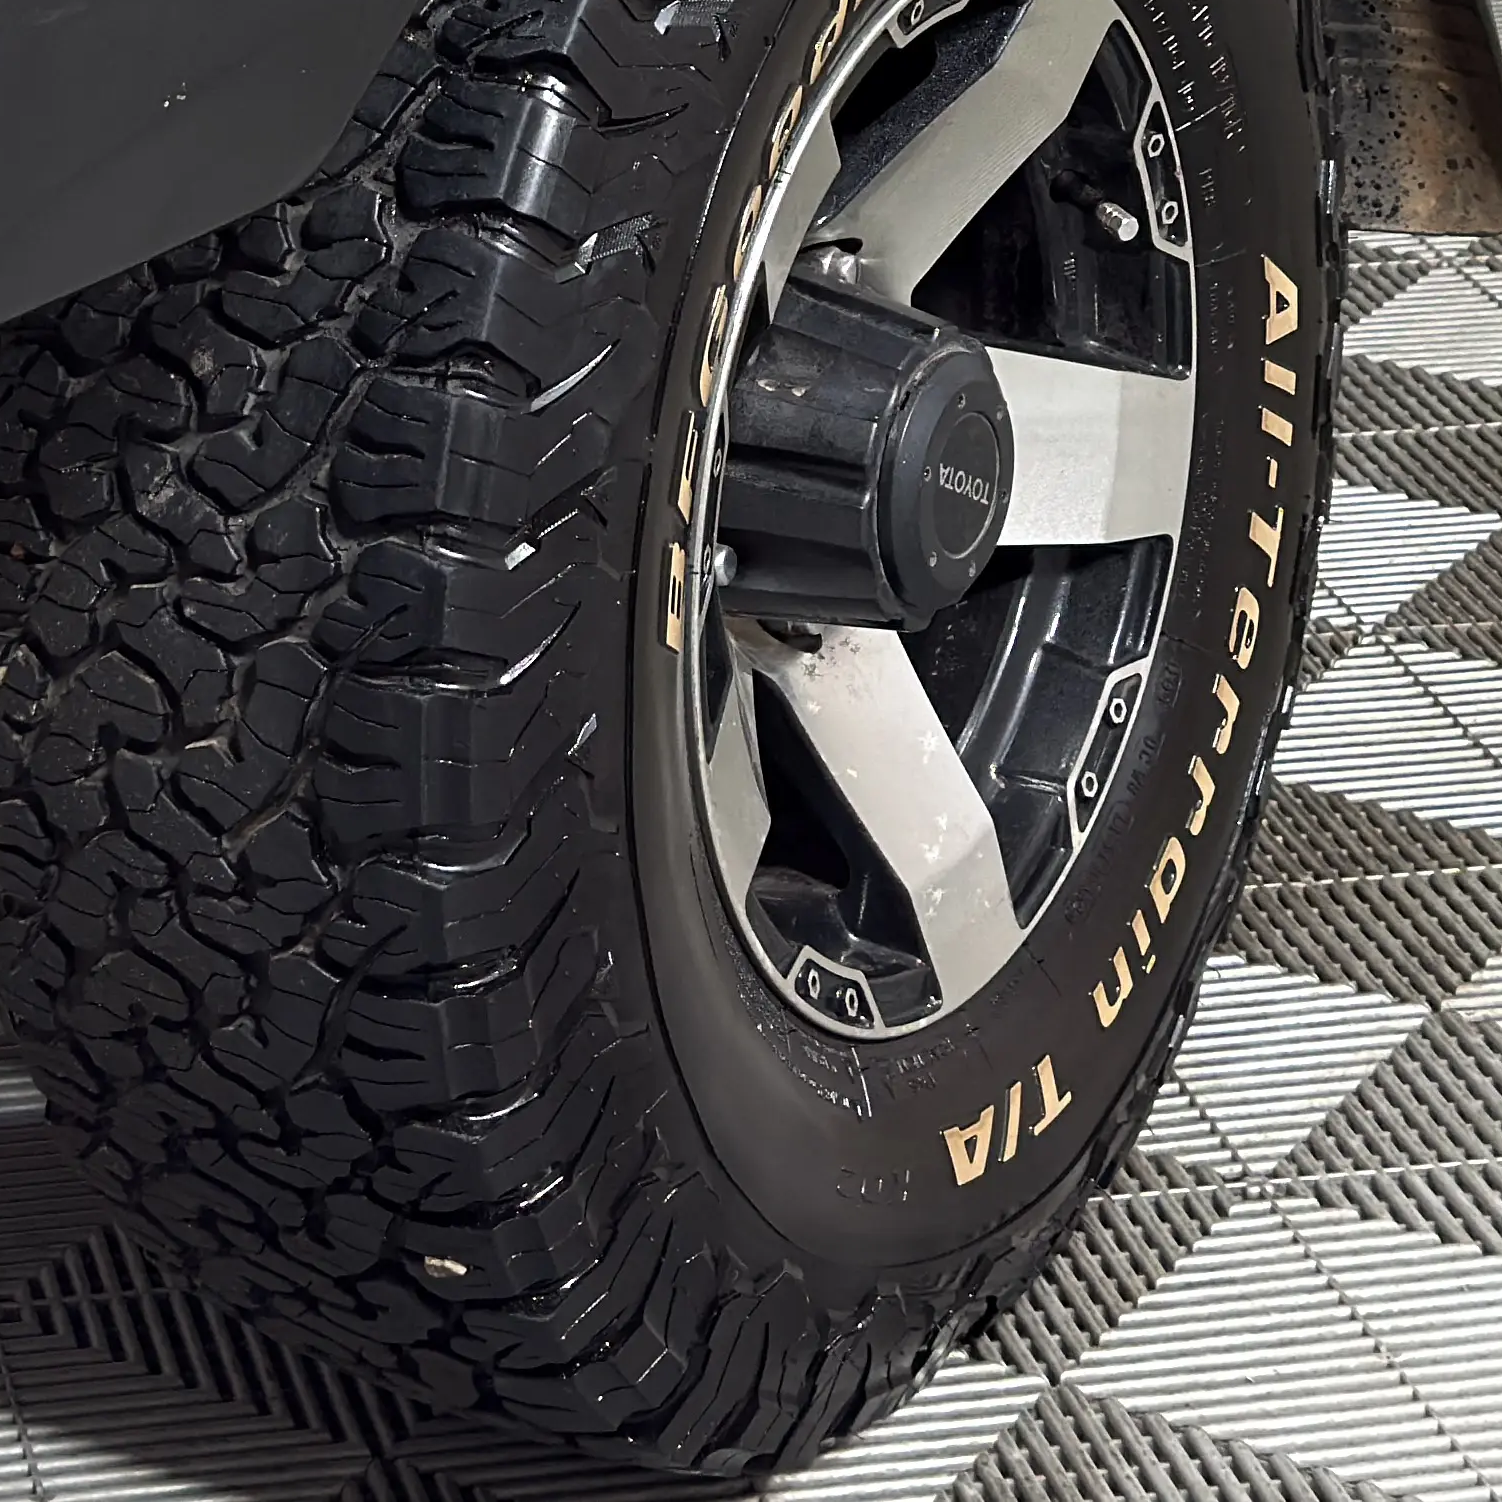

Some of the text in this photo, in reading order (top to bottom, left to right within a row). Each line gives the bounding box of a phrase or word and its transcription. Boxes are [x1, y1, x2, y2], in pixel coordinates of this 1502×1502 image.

[939, 462, 990, 505] TOYOTA
[1090, 254, 1299, 1027] All-Terrain
[942, 1054, 1073, 1185] T/A
